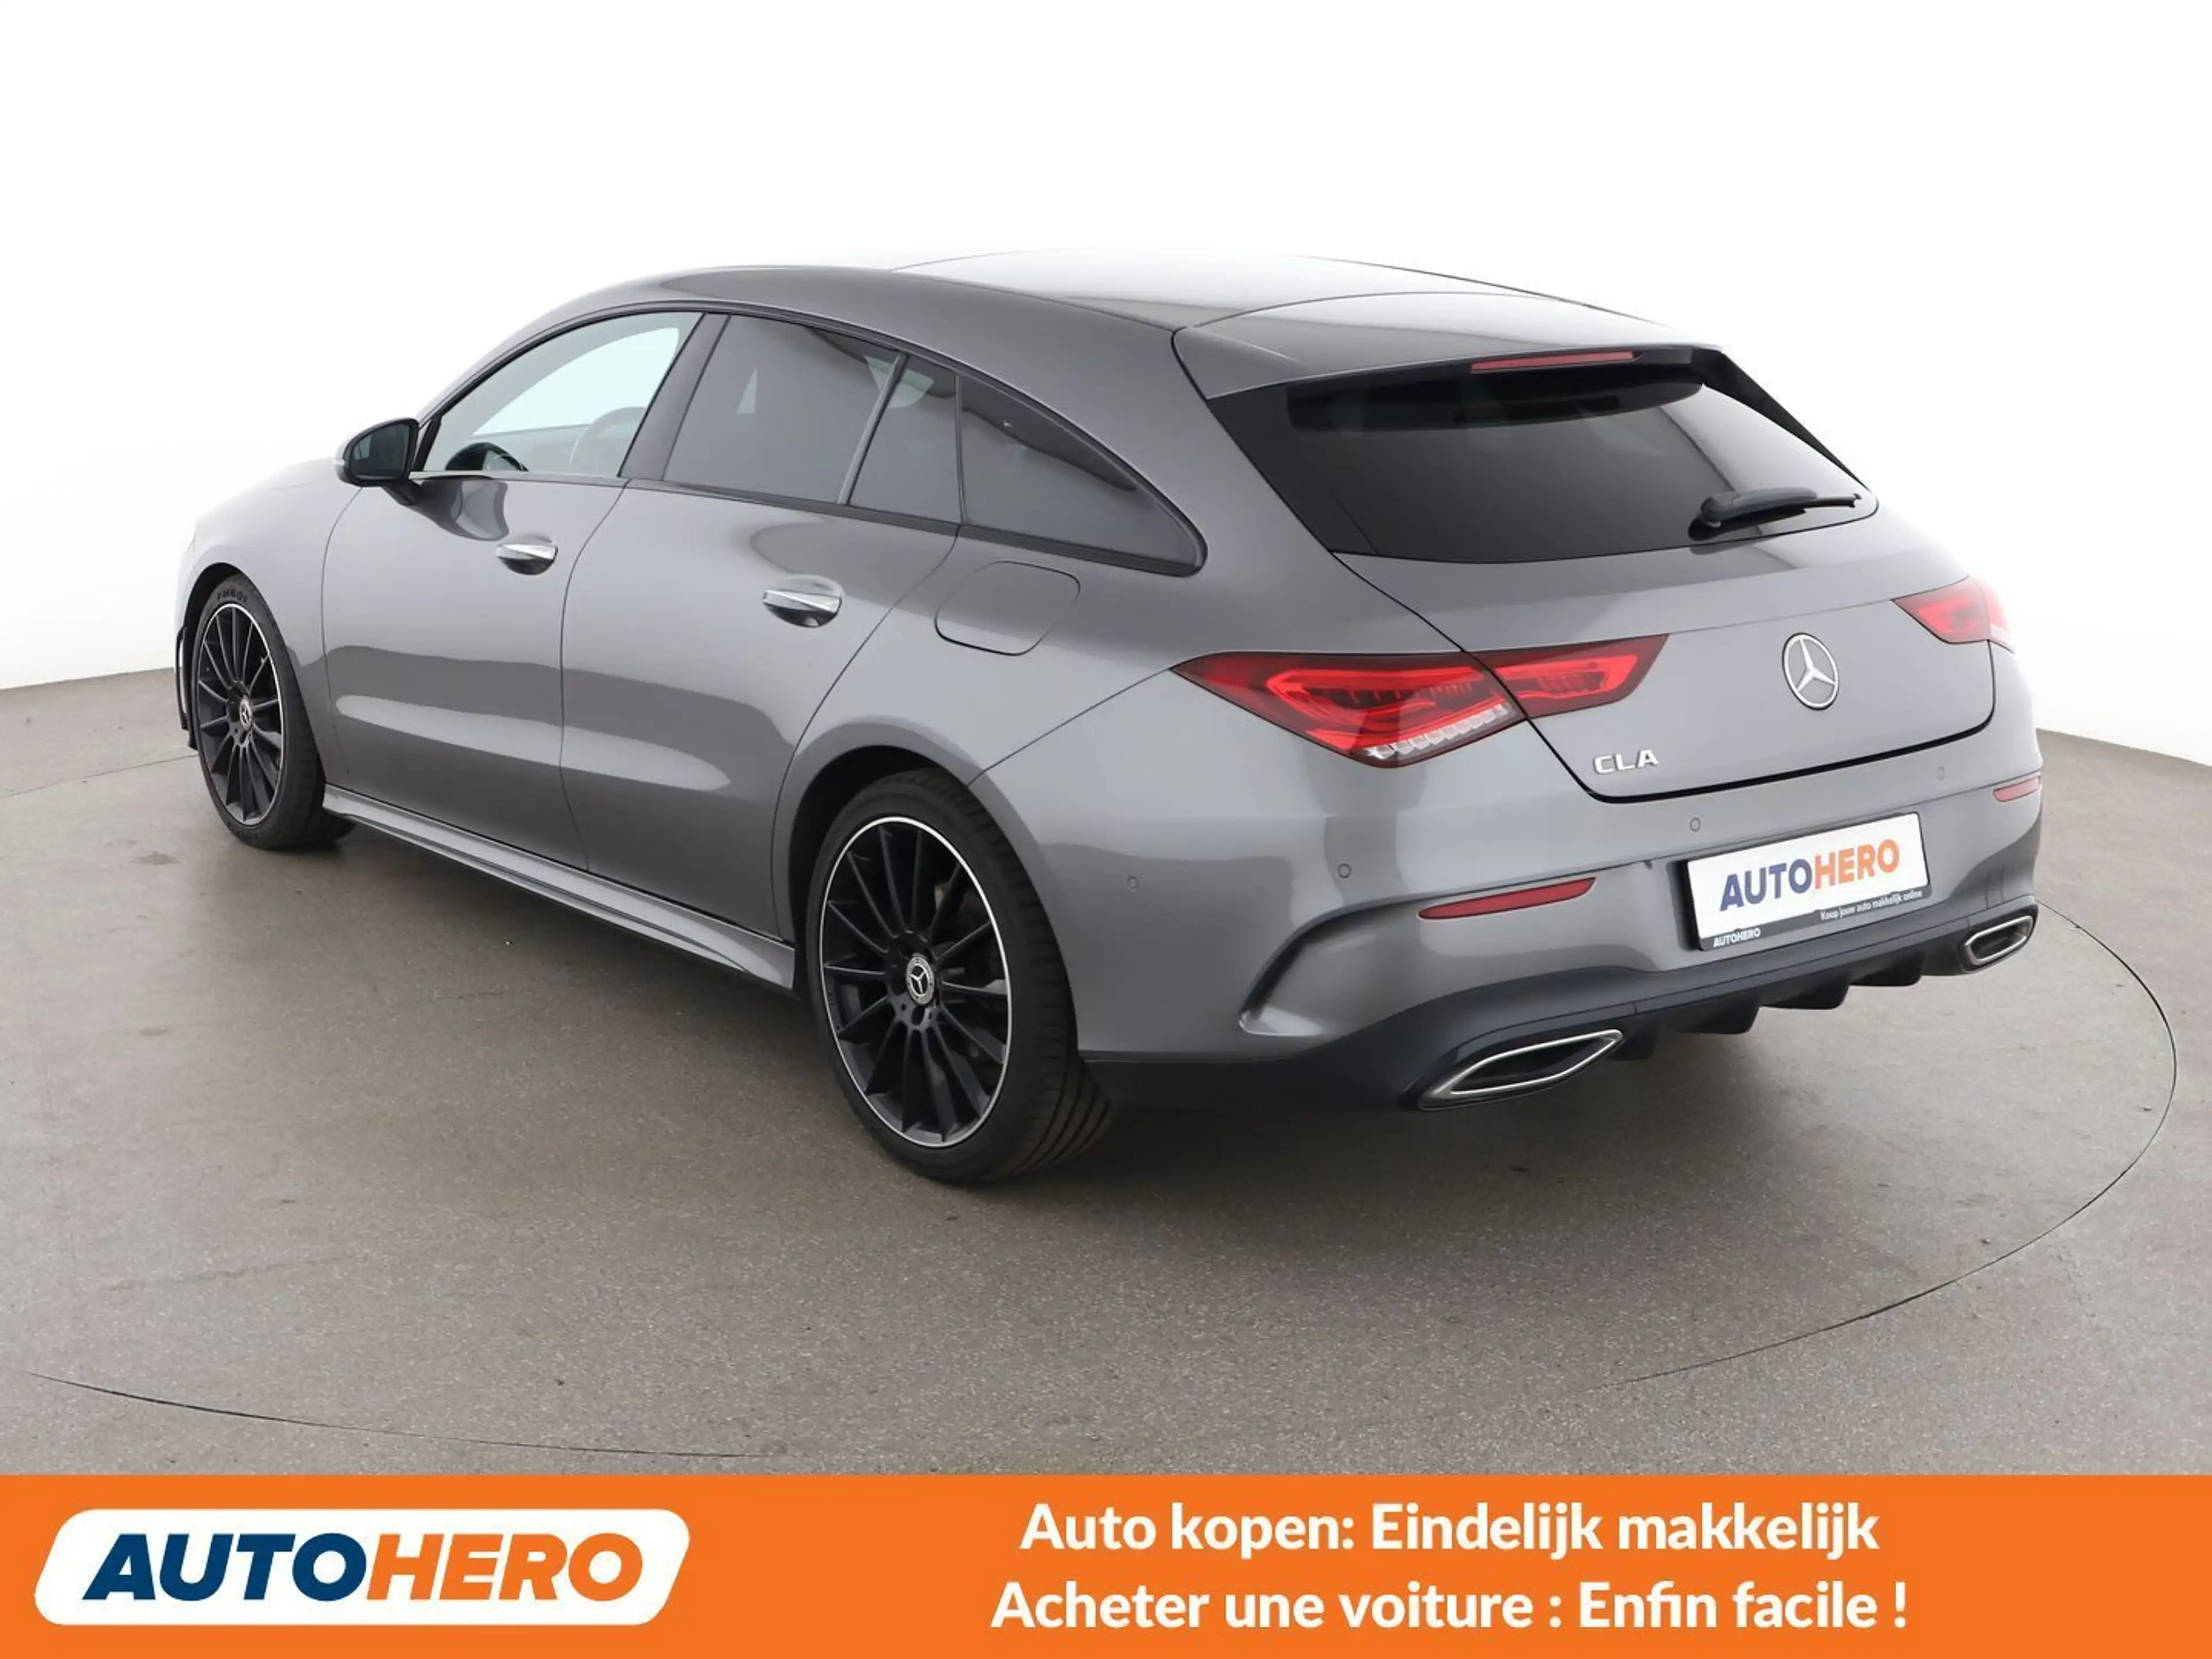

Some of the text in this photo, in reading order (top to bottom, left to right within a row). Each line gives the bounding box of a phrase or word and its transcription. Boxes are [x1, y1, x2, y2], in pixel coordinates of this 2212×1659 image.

[1593, 749, 1659, 774] CLA
[1719, 839, 1900, 911] AUTOHERO
[1820, 890, 1923, 921] Koop jouw auto makkelijk online
[1713, 927, 1762, 948] AUTOHERO
